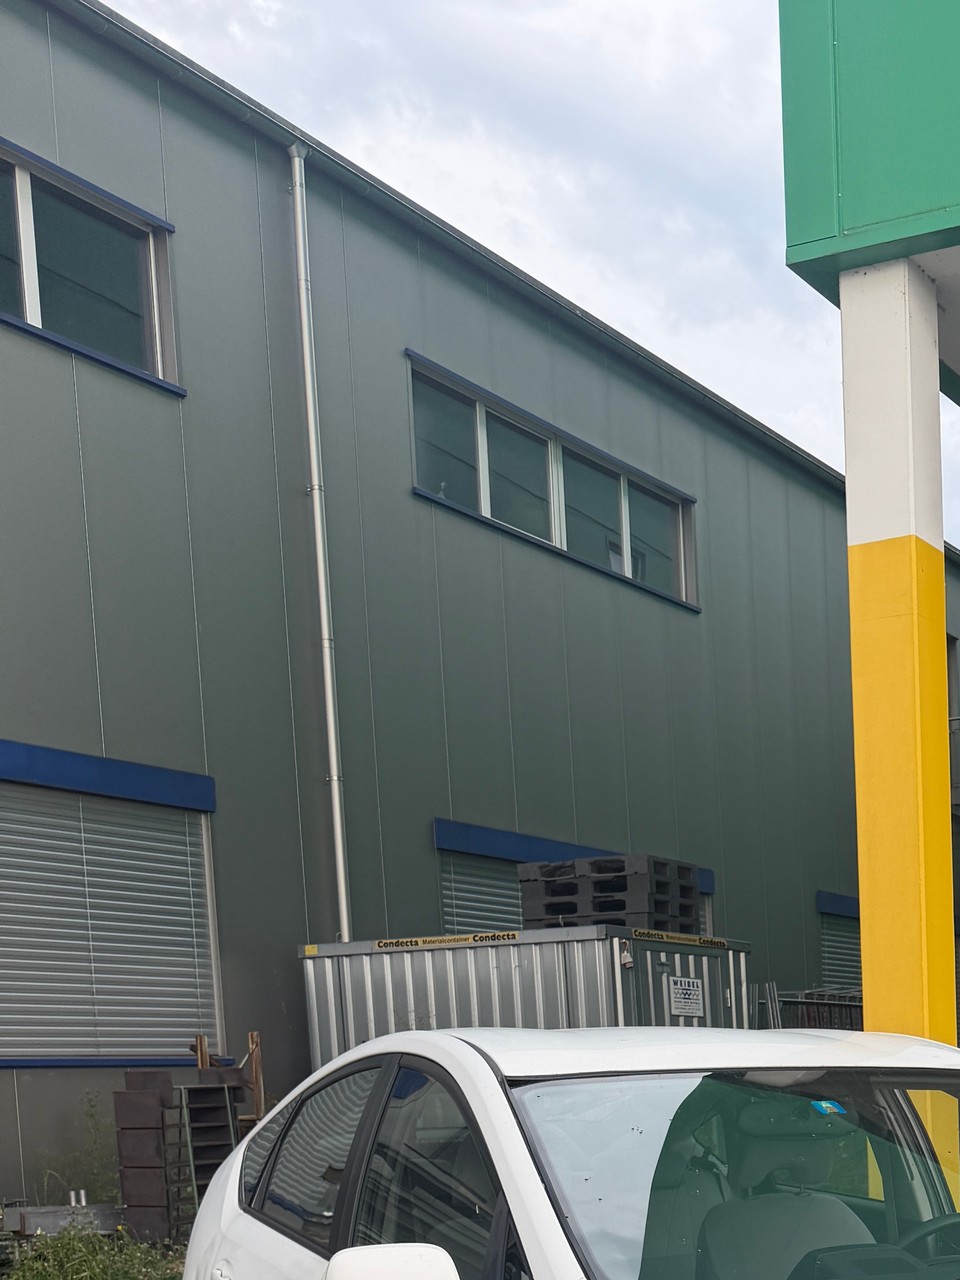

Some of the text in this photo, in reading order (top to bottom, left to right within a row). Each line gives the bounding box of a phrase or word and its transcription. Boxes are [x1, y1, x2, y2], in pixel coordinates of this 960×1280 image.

[377, 932, 517, 948] Condecta Materialcontainer Condecta
[634, 929, 664, 940] Condecta
[698, 938, 725, 947] Condecta
[673, 979, 699, 988] WEIBEL
